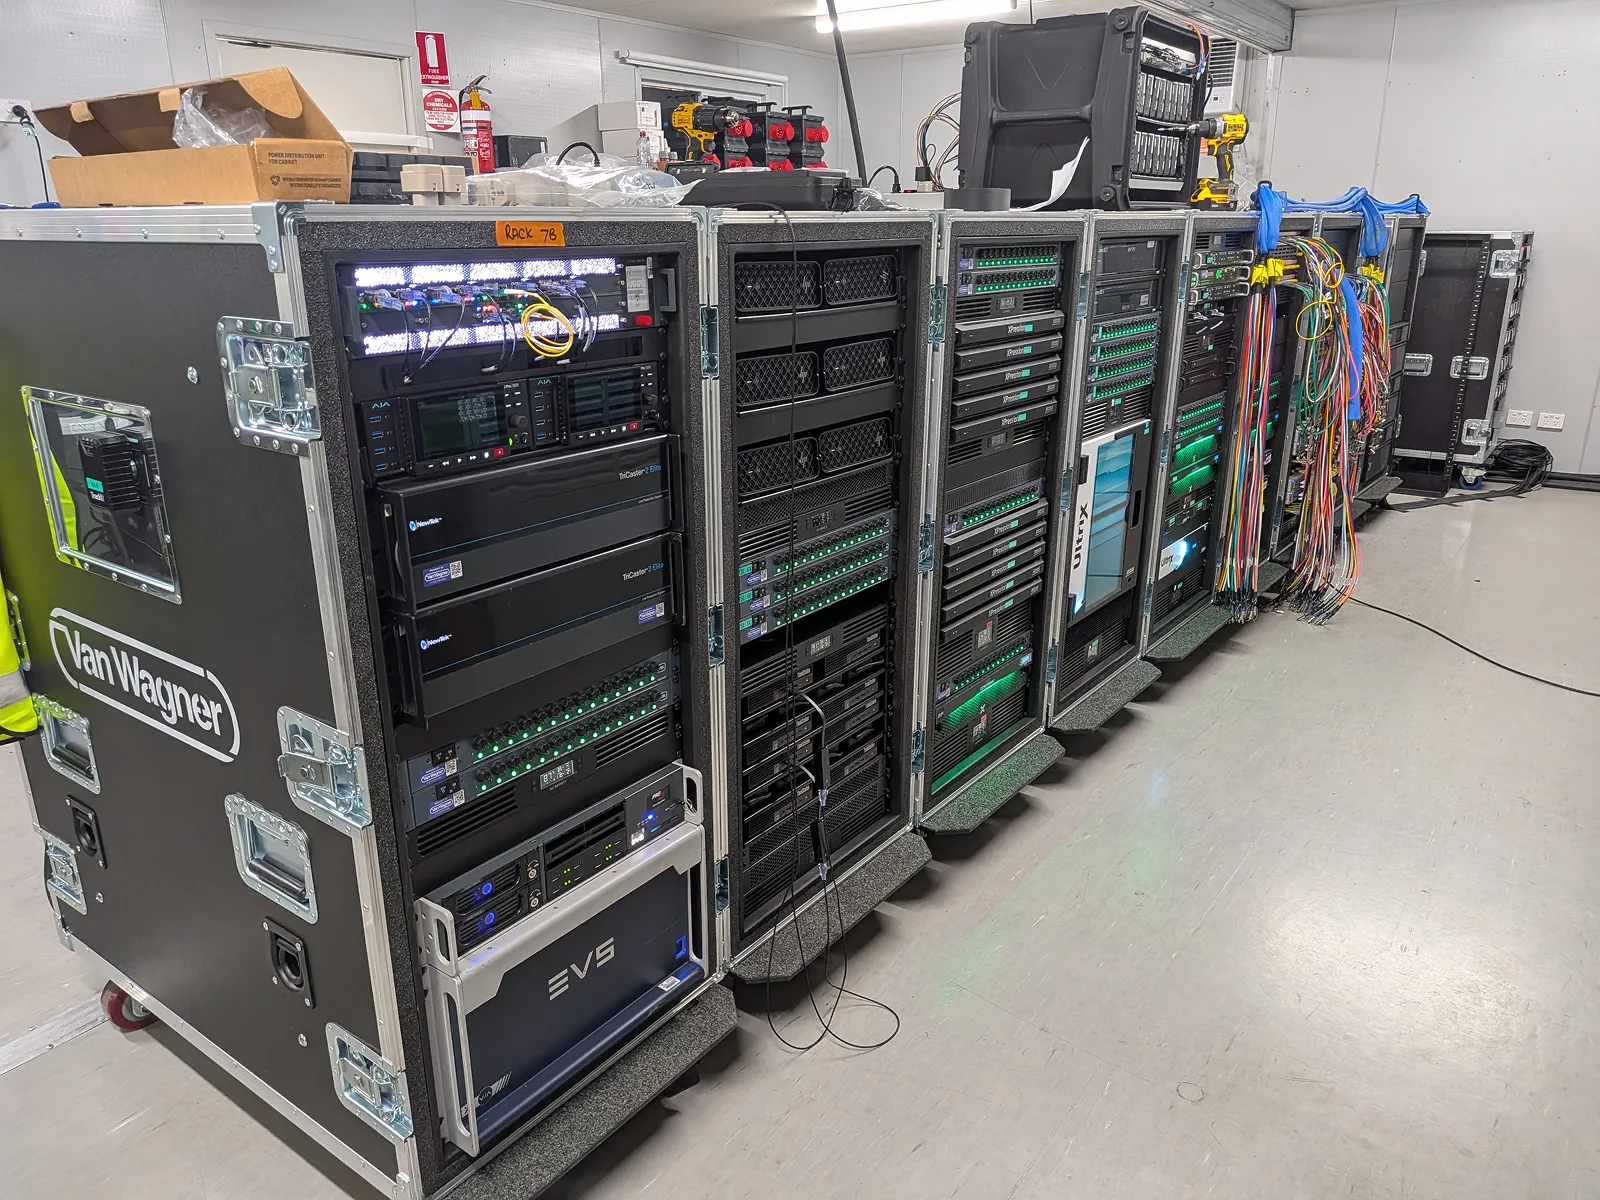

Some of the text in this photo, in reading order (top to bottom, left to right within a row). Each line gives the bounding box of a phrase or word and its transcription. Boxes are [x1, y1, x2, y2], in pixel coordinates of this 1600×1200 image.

[505, 224, 533, 240] RACK
[619, 470, 644, 480] TriCaster
[417, 518, 440, 528] NewTek
[622, 569, 647, 581] TriCaster
[428, 635, 449, 645] NewTek
[66, 626, 222, 736] Van Wagner
[548, 936, 615, 1001] EVS
